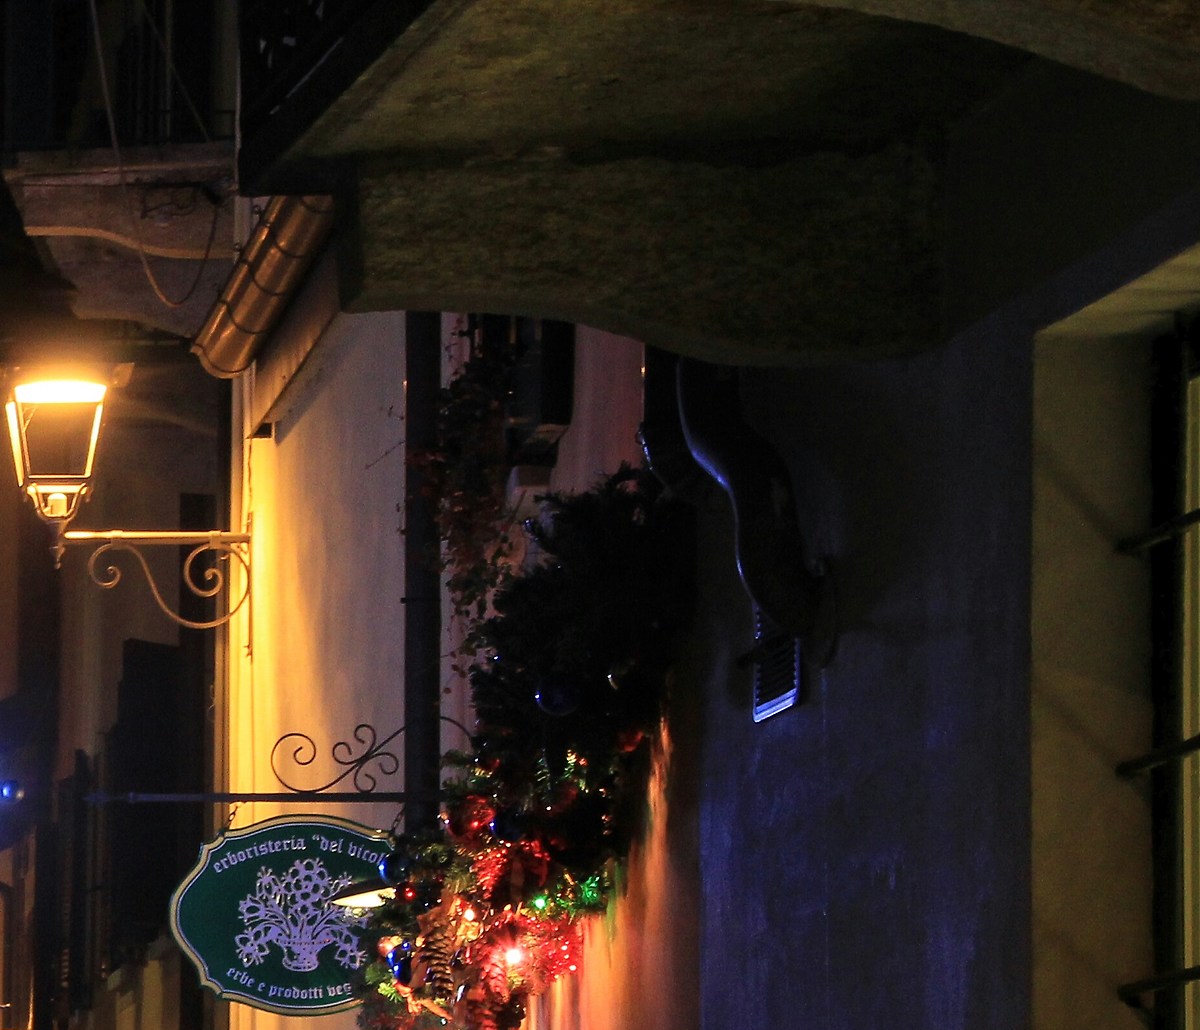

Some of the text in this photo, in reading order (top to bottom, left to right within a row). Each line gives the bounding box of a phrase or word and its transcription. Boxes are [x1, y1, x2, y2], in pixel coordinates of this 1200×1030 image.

[213, 834, 307, 874] erboristeria
[347, 841, 387, 866] vicol
[226, 966, 353, 1000] erbe e prodotti veg
